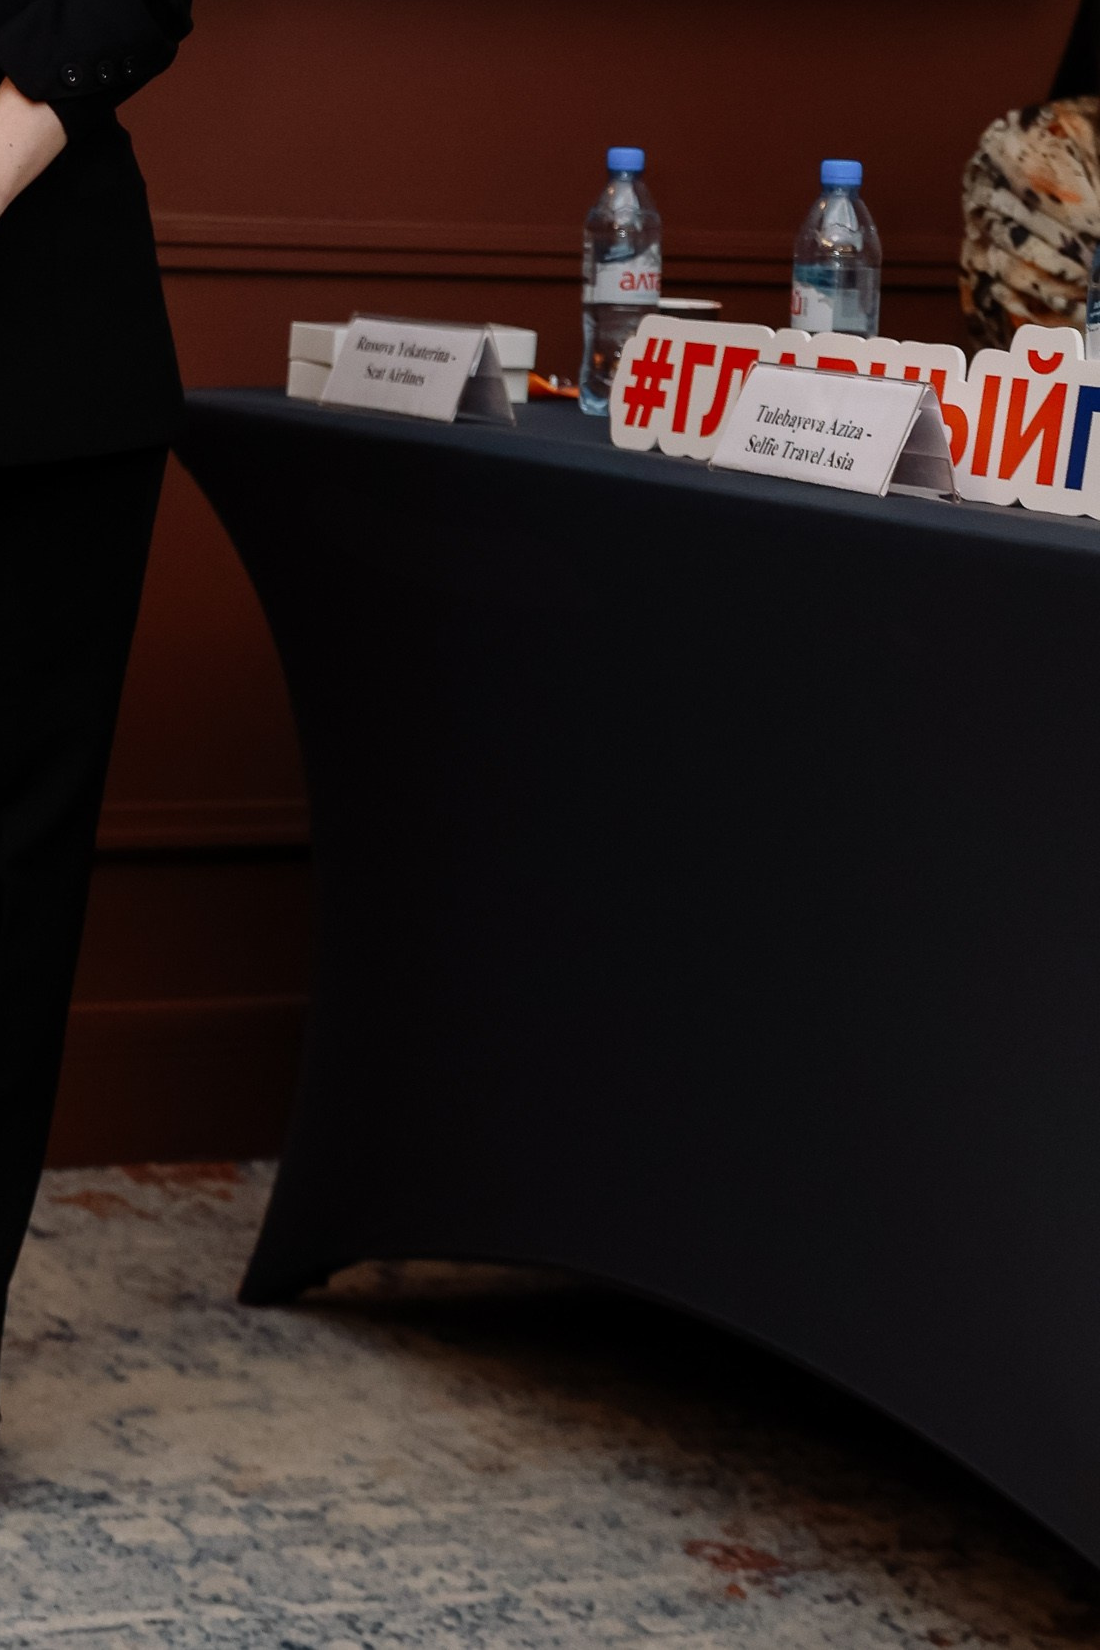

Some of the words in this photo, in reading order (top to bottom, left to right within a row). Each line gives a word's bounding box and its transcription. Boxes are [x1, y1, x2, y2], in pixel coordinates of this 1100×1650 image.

[387, 368, 425, 387] Airlines
[756, 404, 826, 433] Tulebayeva
[826, 419, 864, 440] Aziza
[745, 434, 779, 457] Selfie
[781, 440, 825, 465] Travel
[823, 450, 855, 471] Asia
